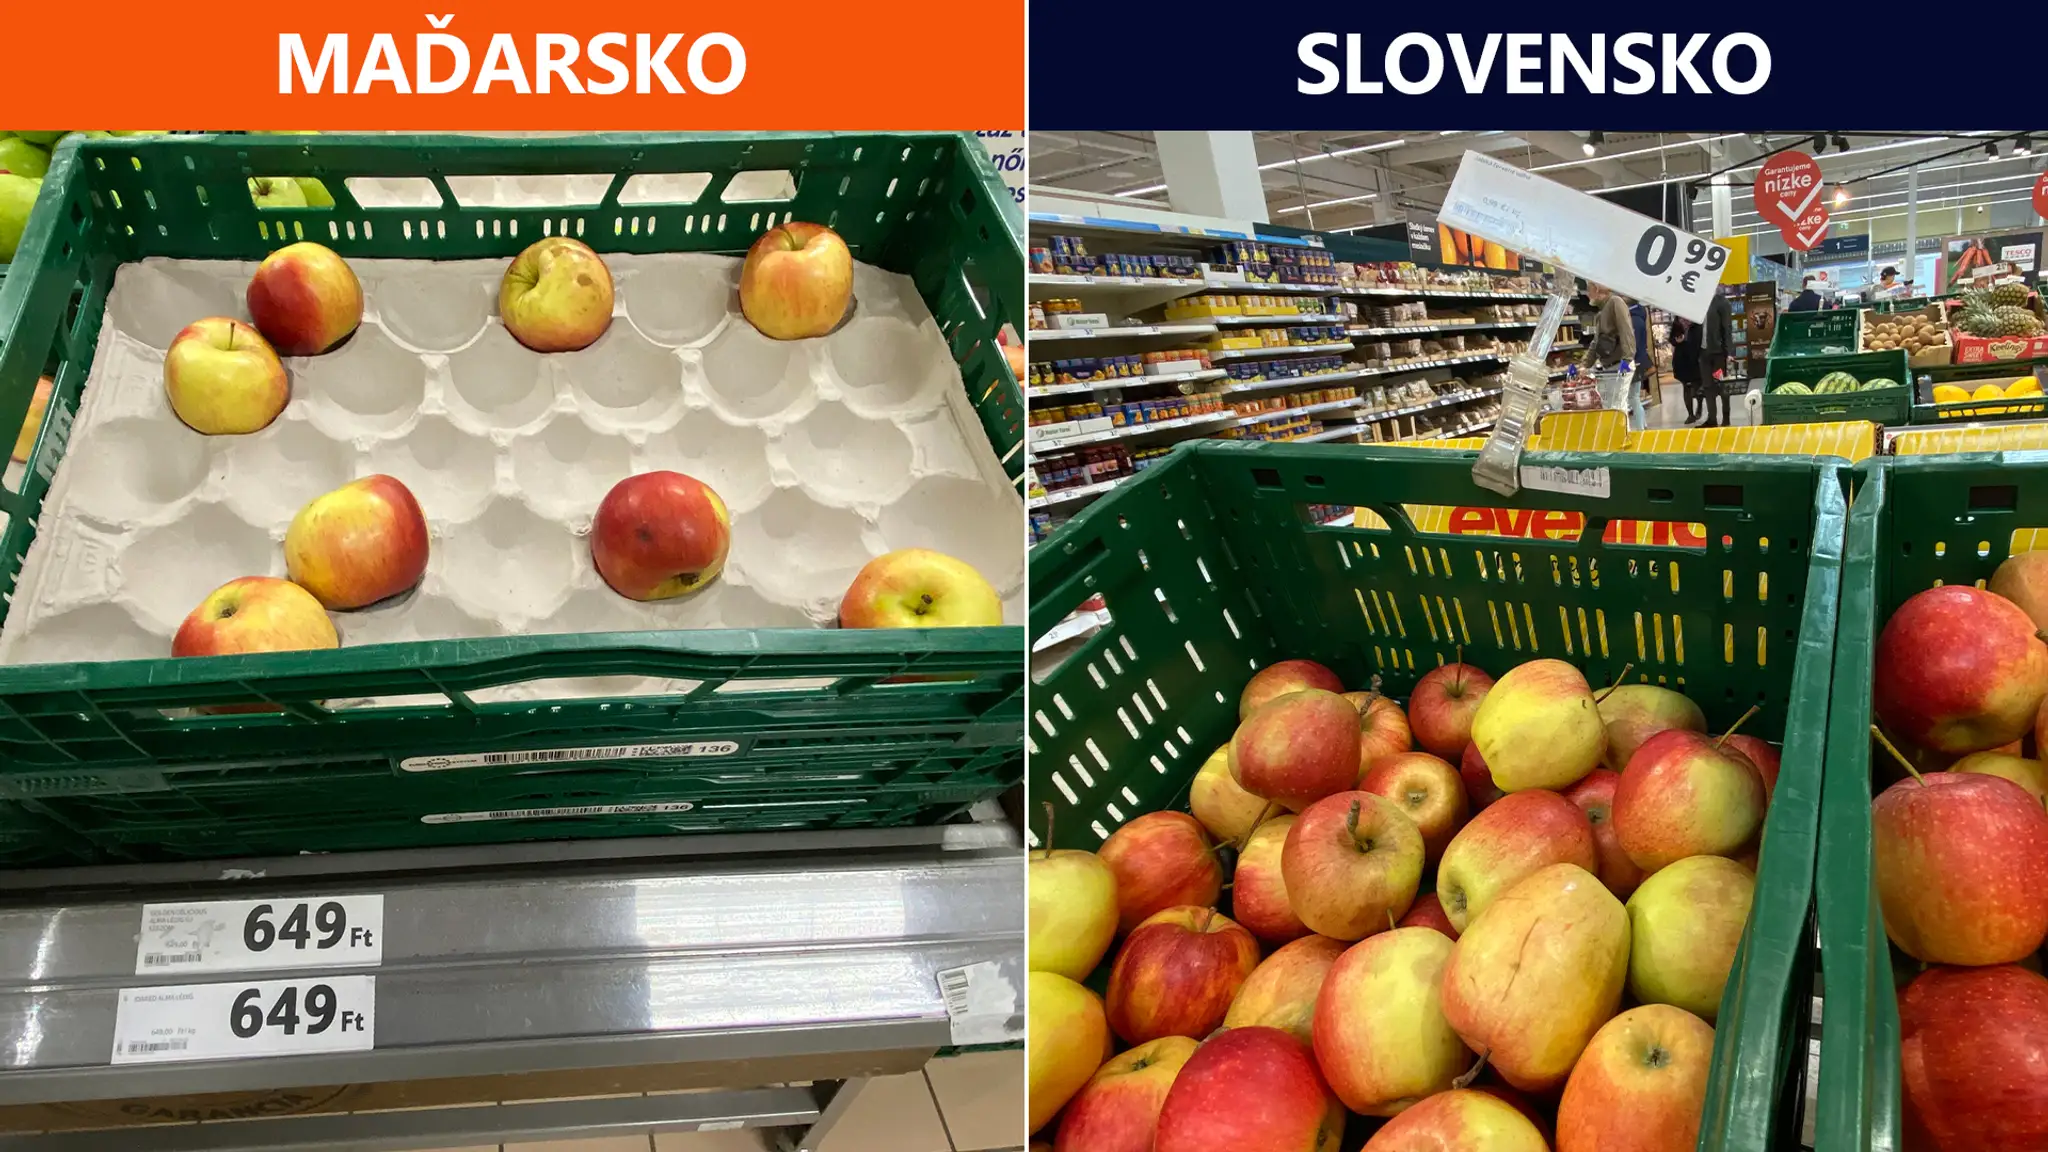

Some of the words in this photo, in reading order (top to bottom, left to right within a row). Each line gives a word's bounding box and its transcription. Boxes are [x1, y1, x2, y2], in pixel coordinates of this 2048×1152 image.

[1764, 163, 1811, 176] Garantujeme
[1764, 173, 1812, 193] nízke
[1780, 190, 1796, 198] ceny
[1835, 242, 1841, 250] 1
[1680, 270, 1701, 293] €
[699, 745, 731, 753] 136
[244, 901, 347, 952] 649
[351, 927, 373, 948] Ft
[230, 984, 338, 1039] 649
[341, 1011, 364, 1032] Ft
